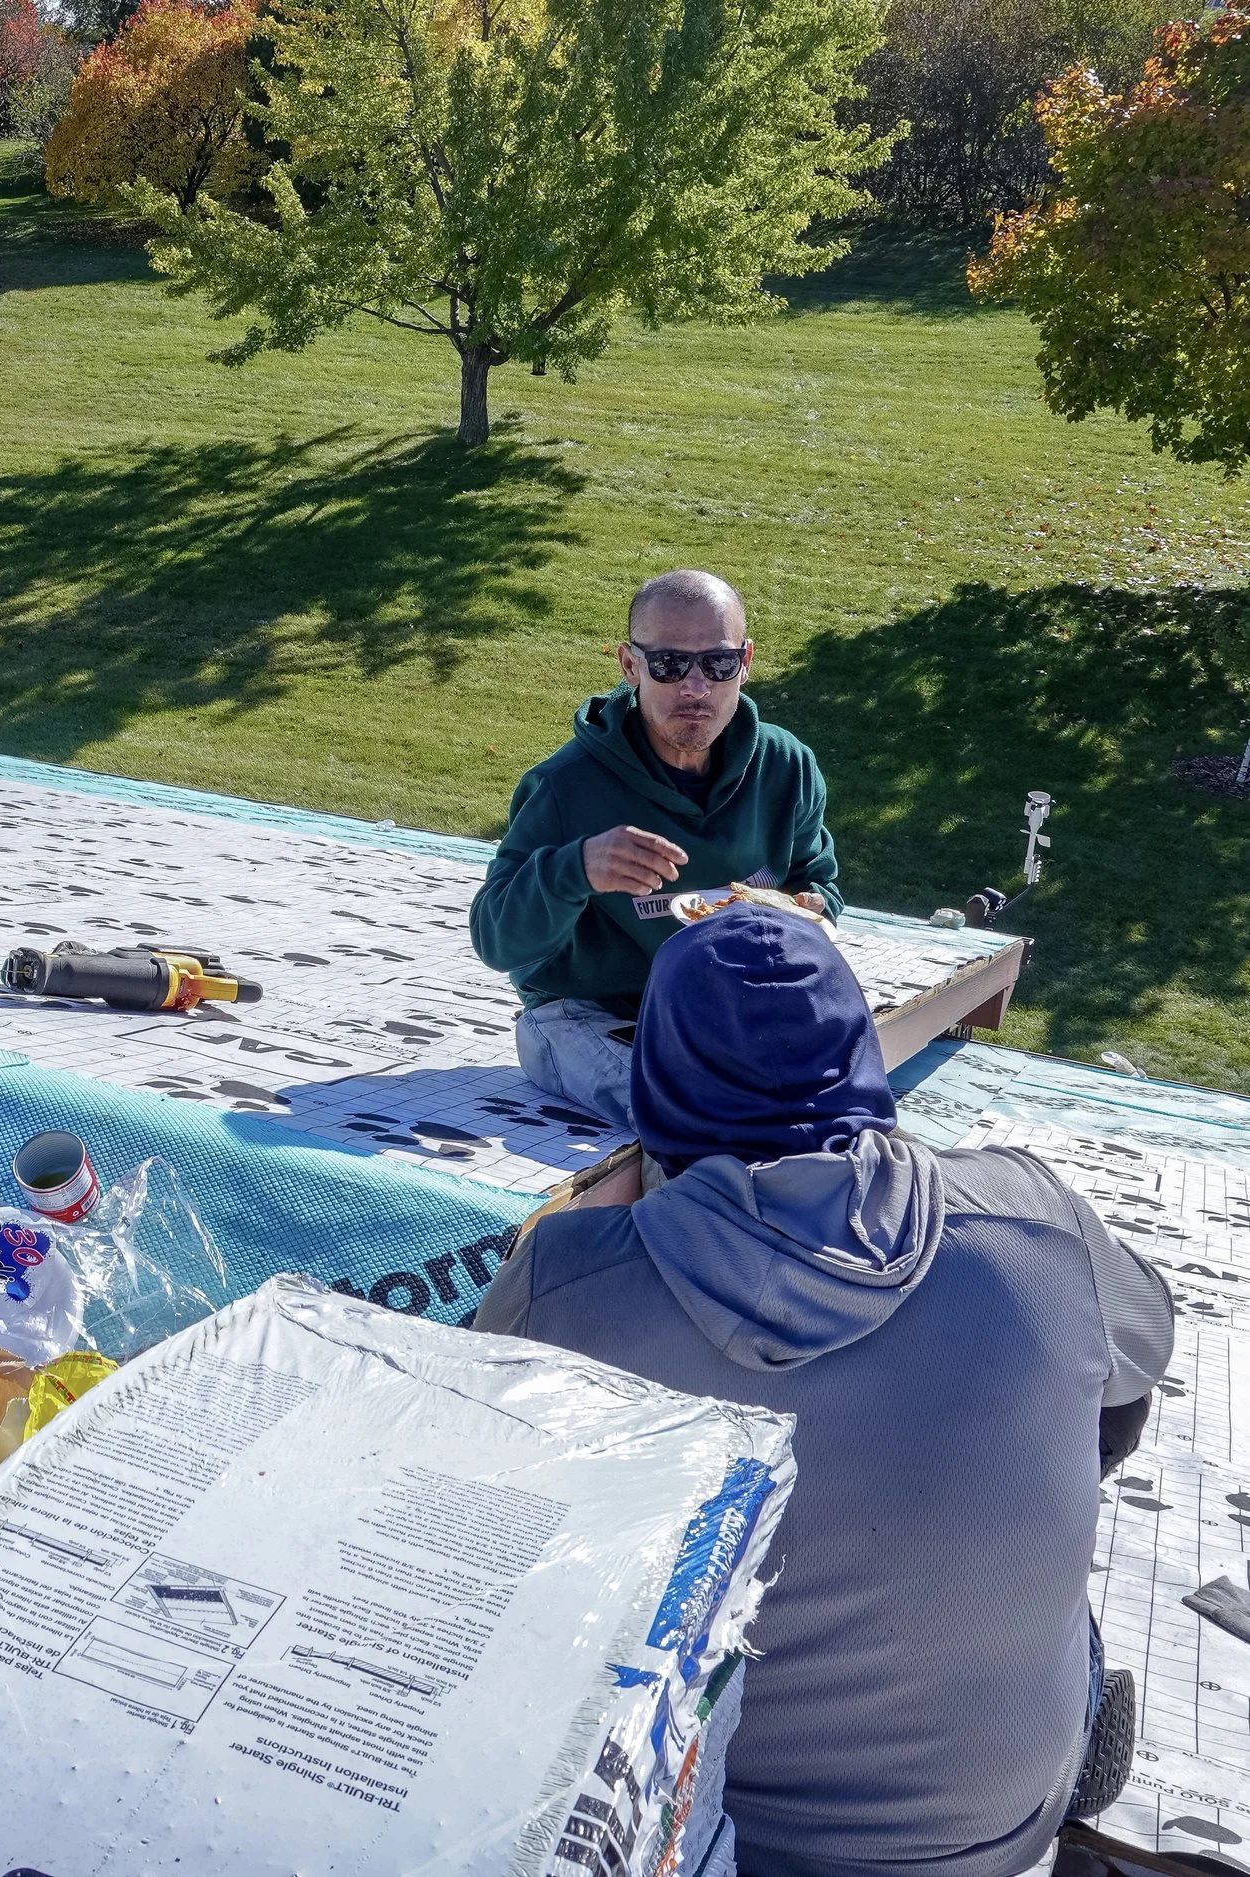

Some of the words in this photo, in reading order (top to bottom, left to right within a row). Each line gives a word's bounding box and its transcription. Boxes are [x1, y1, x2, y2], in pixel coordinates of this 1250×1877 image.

[637, 898, 672, 916] FUTUR
[175, 1031, 353, 1068] GAF
[2, 1227, 45, 1267] 30
[29, 1505, 61, 1522] hilera
[60, 1516, 73, 1526] la
[72, 1521, 88, 1531] de
[88, 1527, 150, 1555] Colocación
[112, 1527, 139, 1542] tejas
[140, 1538, 156, 1548] de
[308, 1605, 338, 1620] sealant
[338, 1616, 357, 1627] own
[357, 1623, 368, 1632] its
[461, 1616, 477, 1627] Fig.
[477, 1622, 495, 1633] See
[294, 1620, 337, 1641] Starter
[368, 1627, 384, 1638] has
[403, 1642, 412, 1650] is
[411, 1635, 431, 1647] Each
[44, 1646, 61, 1658] de
[219, 1643, 230, 1654] 2
[230, 1645, 246, 1660] Fig.
[384, 1646, 400, 1655] of
[411, 1645, 441, 1660] Starter
[431, 1642, 462, 1657] pieces.
[441, 1655, 475, 1671] Shingle
[461, 1653, 478, 1664] two
[13, 1661, 44, 1680] Tejas
[287, 1662, 313, 1675] Driven
[401, 1651, 470, 1681] Installation
[235, 1672, 248, 1680] of
[311, 1669, 351, 1689] Improperly
[231, 1681, 249, 1692] you
[247, 1676, 305, 1700] manufacturer
[248, 1687, 267, 1698] that
[237, 1693, 263, 1707] using
[304, 1696, 320, 1706] the
[367, 1690, 393, 1704] Driven
[222, 1700, 236, 1710] for
[262, 1703, 288, 1718] When
[266, 1693, 329, 1720] recommended
[319, 1701, 333, 1711] by
[355, 1703, 379, 1717] used.
[392, 1699, 425, 1716] Properly
[234, 1704, 276, 1723] designed
[329, 1716, 338, 1725] is
[332, 1706, 374, 1725] exclusion
[378, 1712, 405, 1727] being
[276, 1719, 285, 1728] is
[290, 1712, 328, 1731] shingles.
[373, 1721, 392, 1732] any
[285, 1723, 316, 1739] Starter
[327, 1726, 362, 1743] asphalt
[346, 1721, 377, 1738] starter,
[391, 1728, 406, 1738] for
[404, 1722, 439, 1738] shingle
[315, 1734, 350, 1752] Shingle
[360, 1739, 385, 1752] most
[377, 1734, 411, 1750] shingle
[405, 1733, 434, 1747] check
[227, 1741, 274, 1765] Starter
[255, 1735, 332, 1772] Instructions
[385, 1748, 405, 1760] with
[410, 1746, 428, 1757] this
[405, 1755, 424, 1766] use
[274, 1758, 326, 1785] Shingle
[399, 1765, 417, 1778] The
[333, 1764, 409, 1799] Installation
[325, 1780, 400, 1813] TRI-BUILT®
